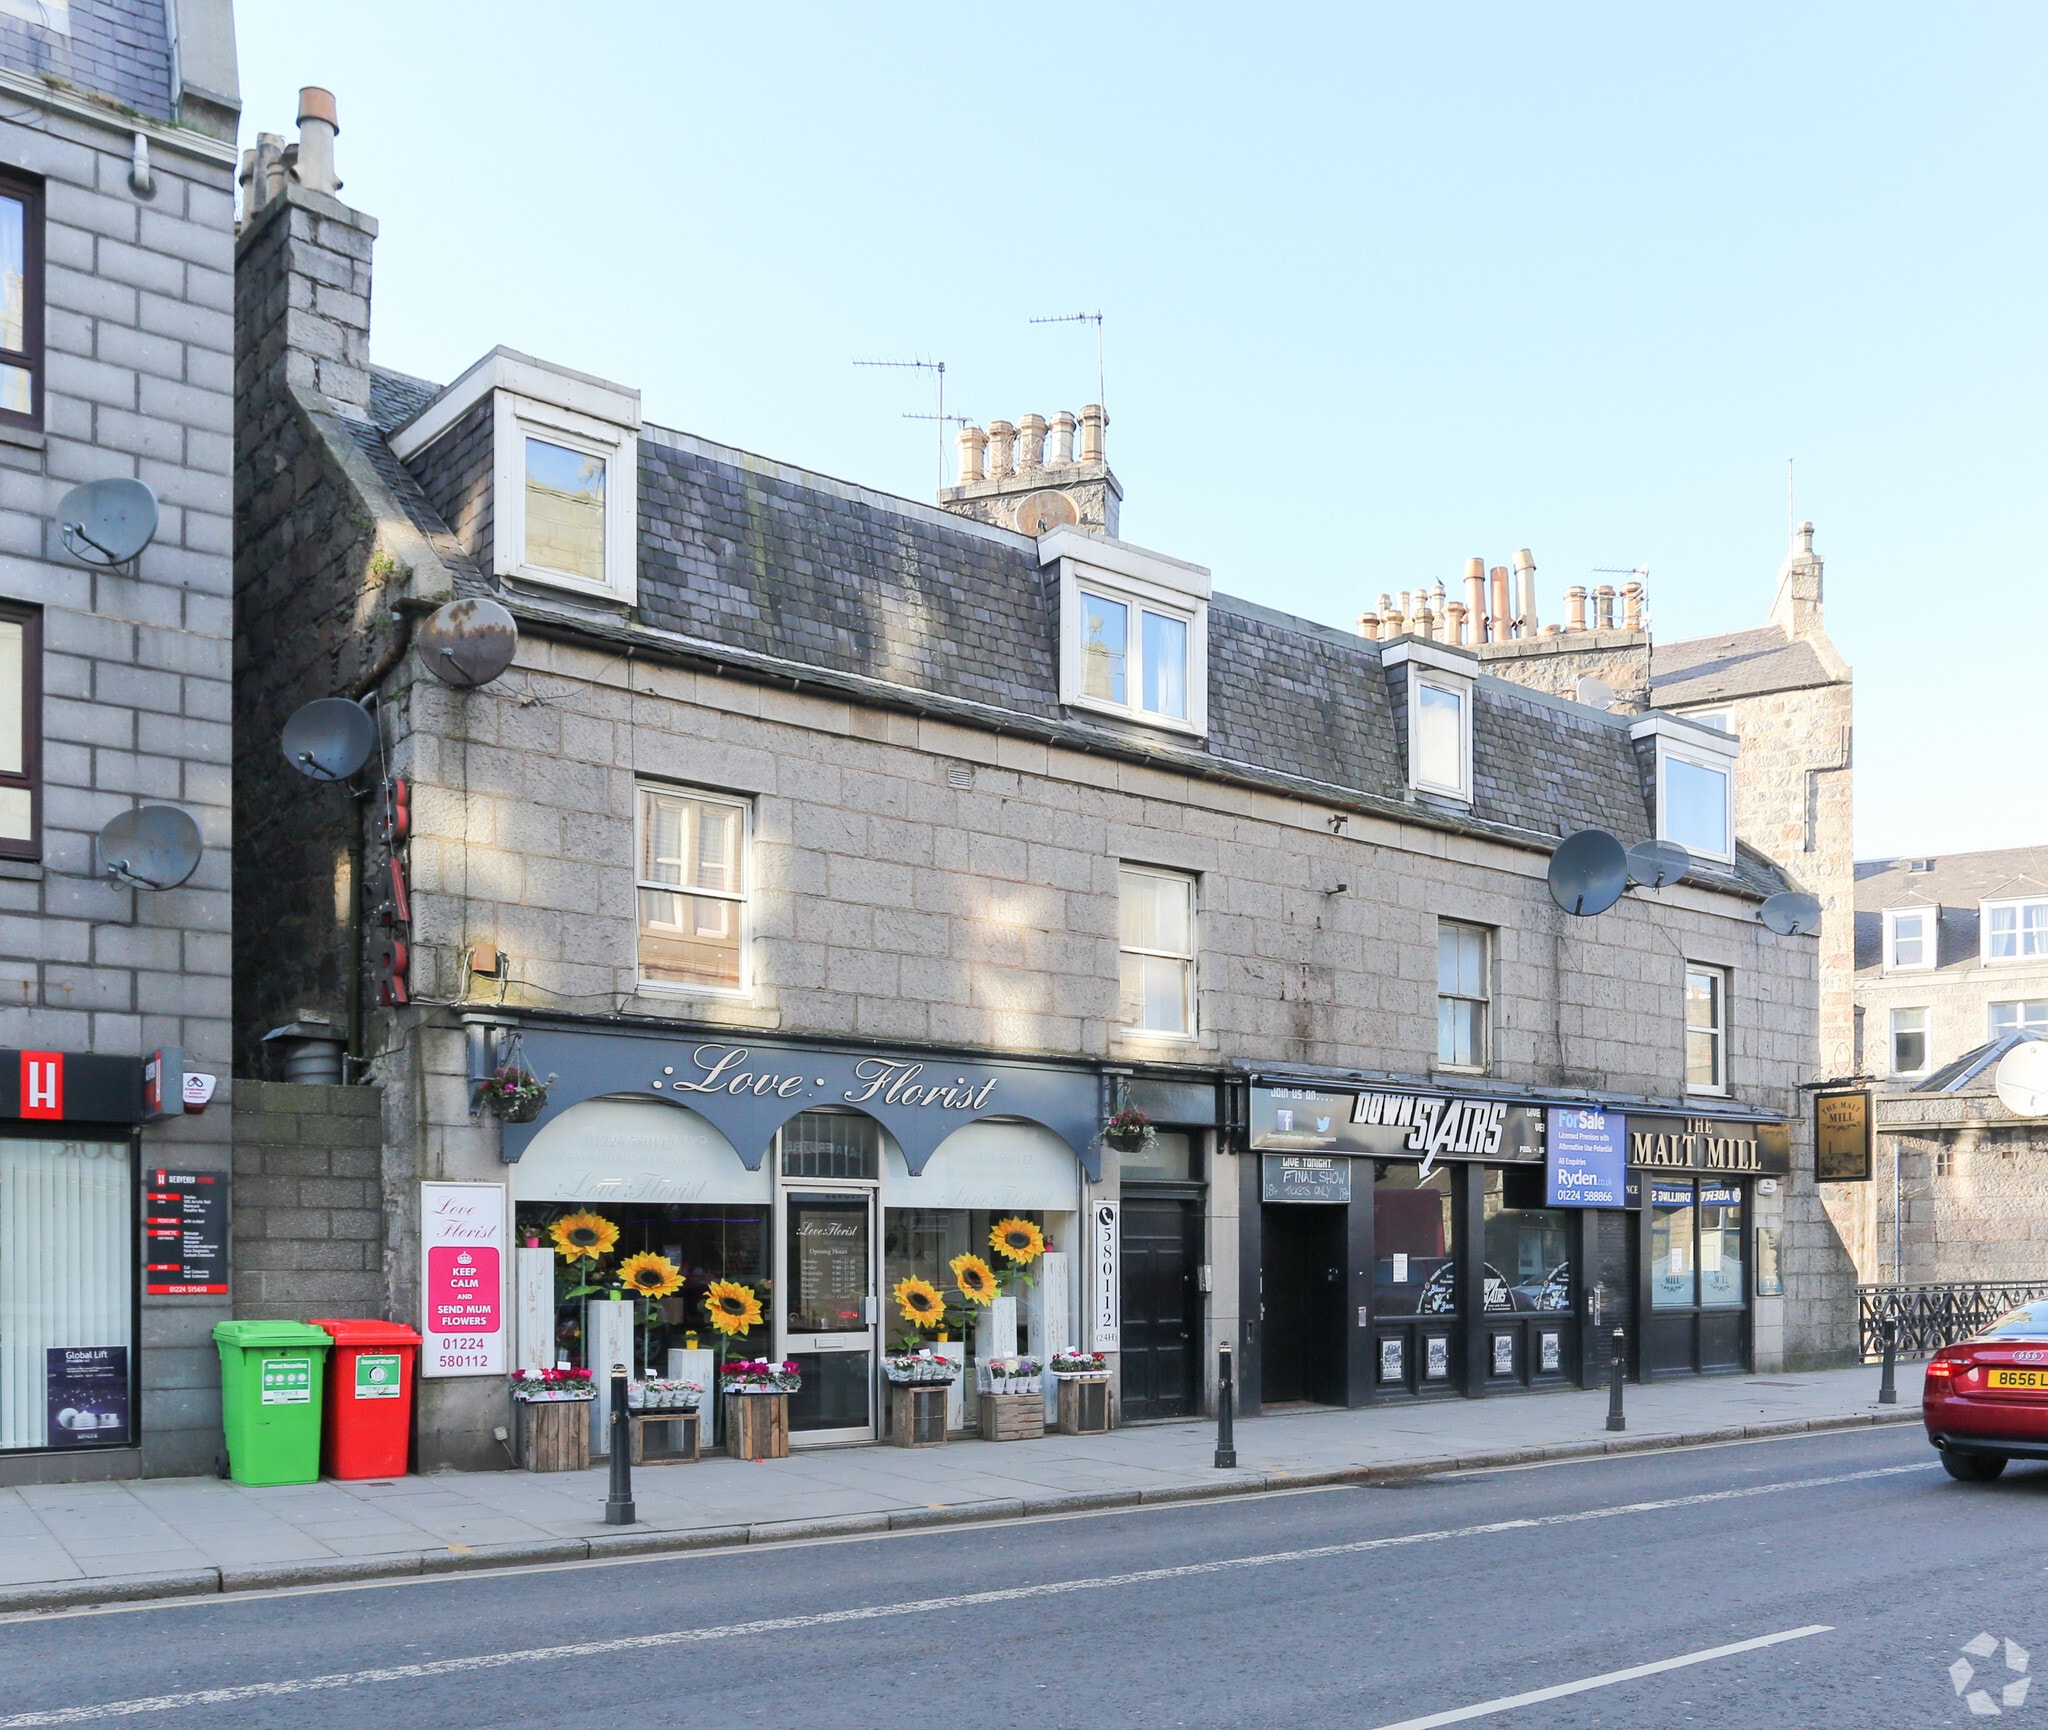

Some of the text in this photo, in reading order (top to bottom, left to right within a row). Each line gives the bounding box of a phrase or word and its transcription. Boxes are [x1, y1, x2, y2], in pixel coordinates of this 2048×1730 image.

[843, 1057, 999, 1110] Florist
[1821, 1101, 1861, 1115] THE MALT
[1829, 1112, 1854, 1122] MILL
[1685, 1117, 1713, 1134] THE
[1632, 1132, 1761, 1170] MALT MILL
[1282, 1157, 1332, 1168] LIVE TONIGHT
[1283, 1169, 1317, 1184] FINAL
[1557, 1190, 1580, 1200] 01224
[432, 1195, 476, 1215] Love
[436, 1219, 497, 1238] Florist
[453, 1268, 477, 1276] KEEP
[450, 1279, 479, 1288] CALM
[438, 1305, 491, 1314] SEND MUM
[442, 1316, 487, 1326] FLOWERS
[443, 1337, 485, 1350] 01224
[1095, 1333, 1118, 1343] (24H)
[65, 1351, 108, 1359] Global Lift
[440, 1355, 488, 1367] 580112
